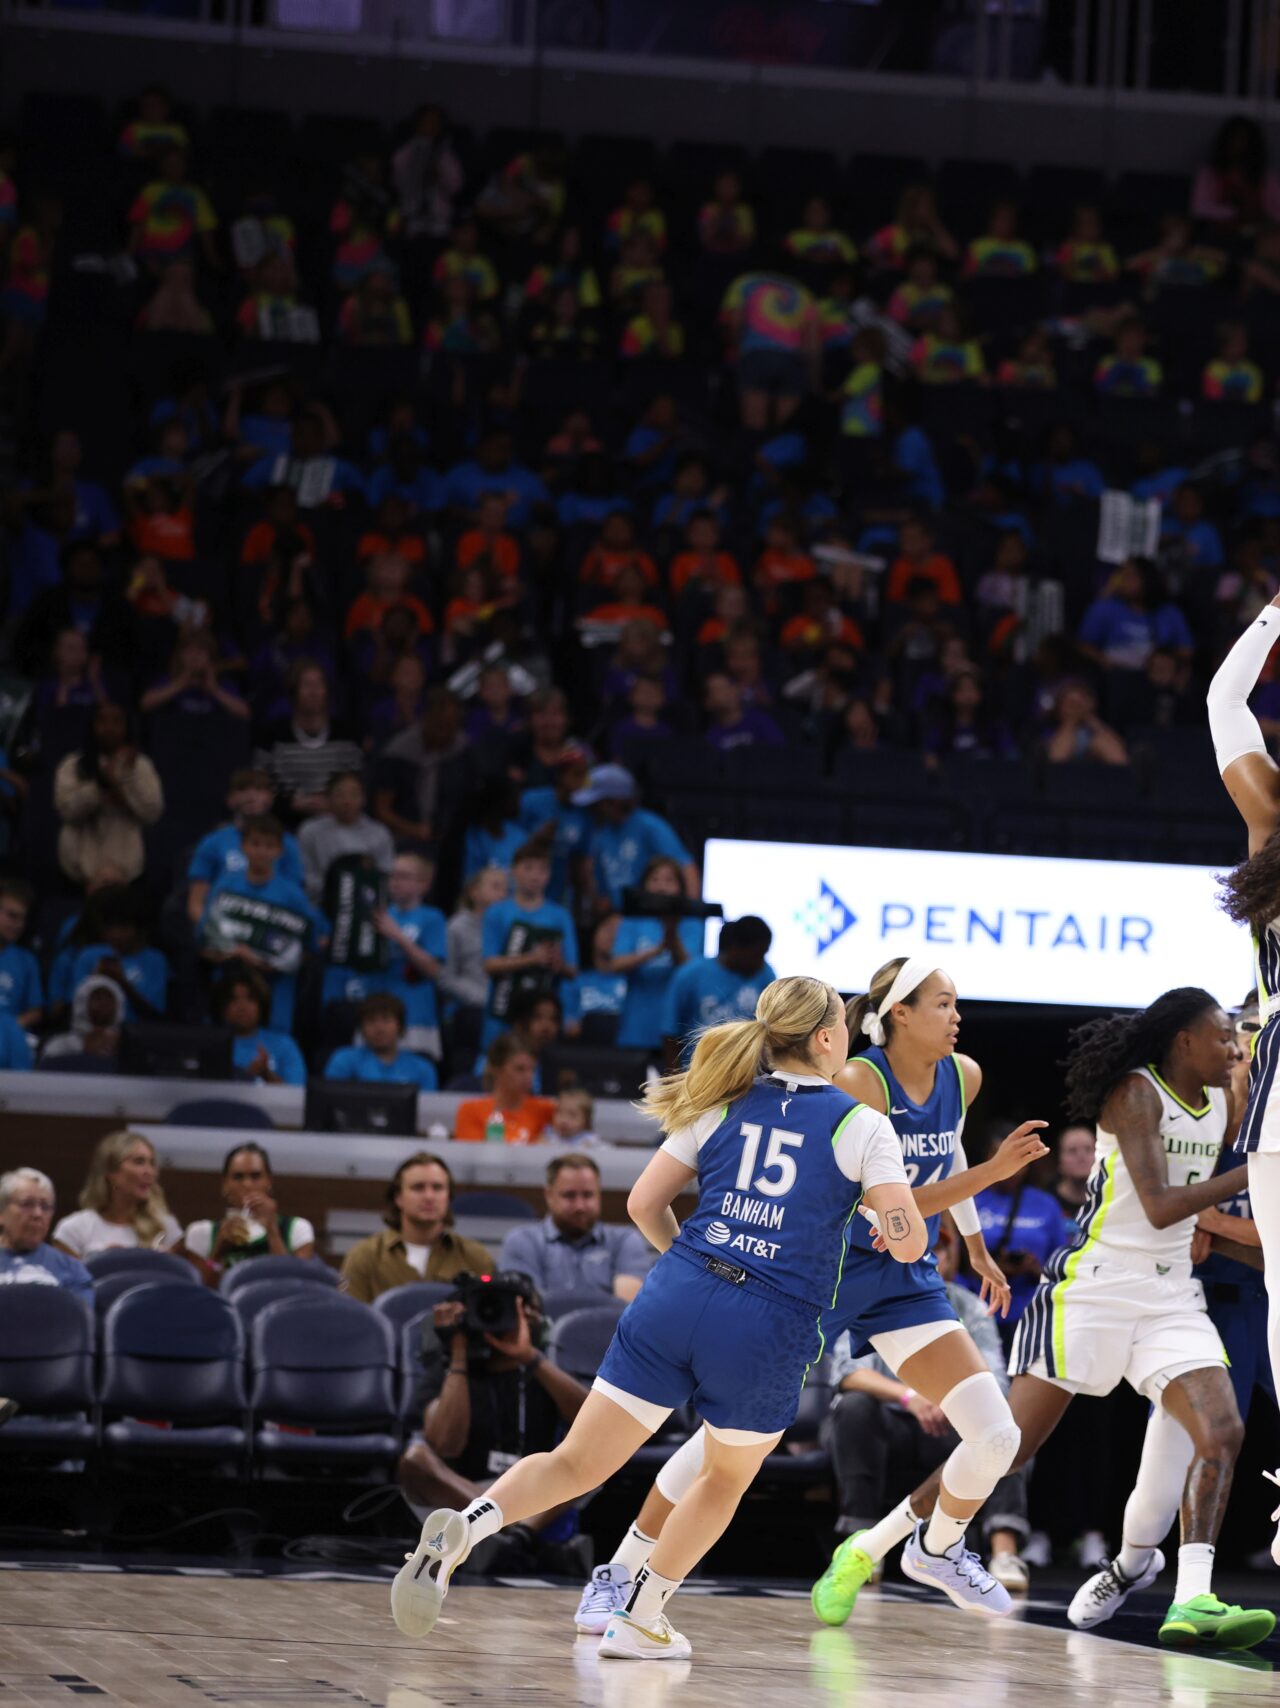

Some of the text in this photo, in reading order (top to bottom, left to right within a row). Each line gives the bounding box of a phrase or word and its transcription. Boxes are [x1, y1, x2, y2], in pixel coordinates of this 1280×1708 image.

[879, 902, 1154, 954] PENTAIR
[735, 1121, 805, 1198] 15
[720, 1191, 786, 1231] BANHAM
[729, 1233, 782, 1260] AT&T
